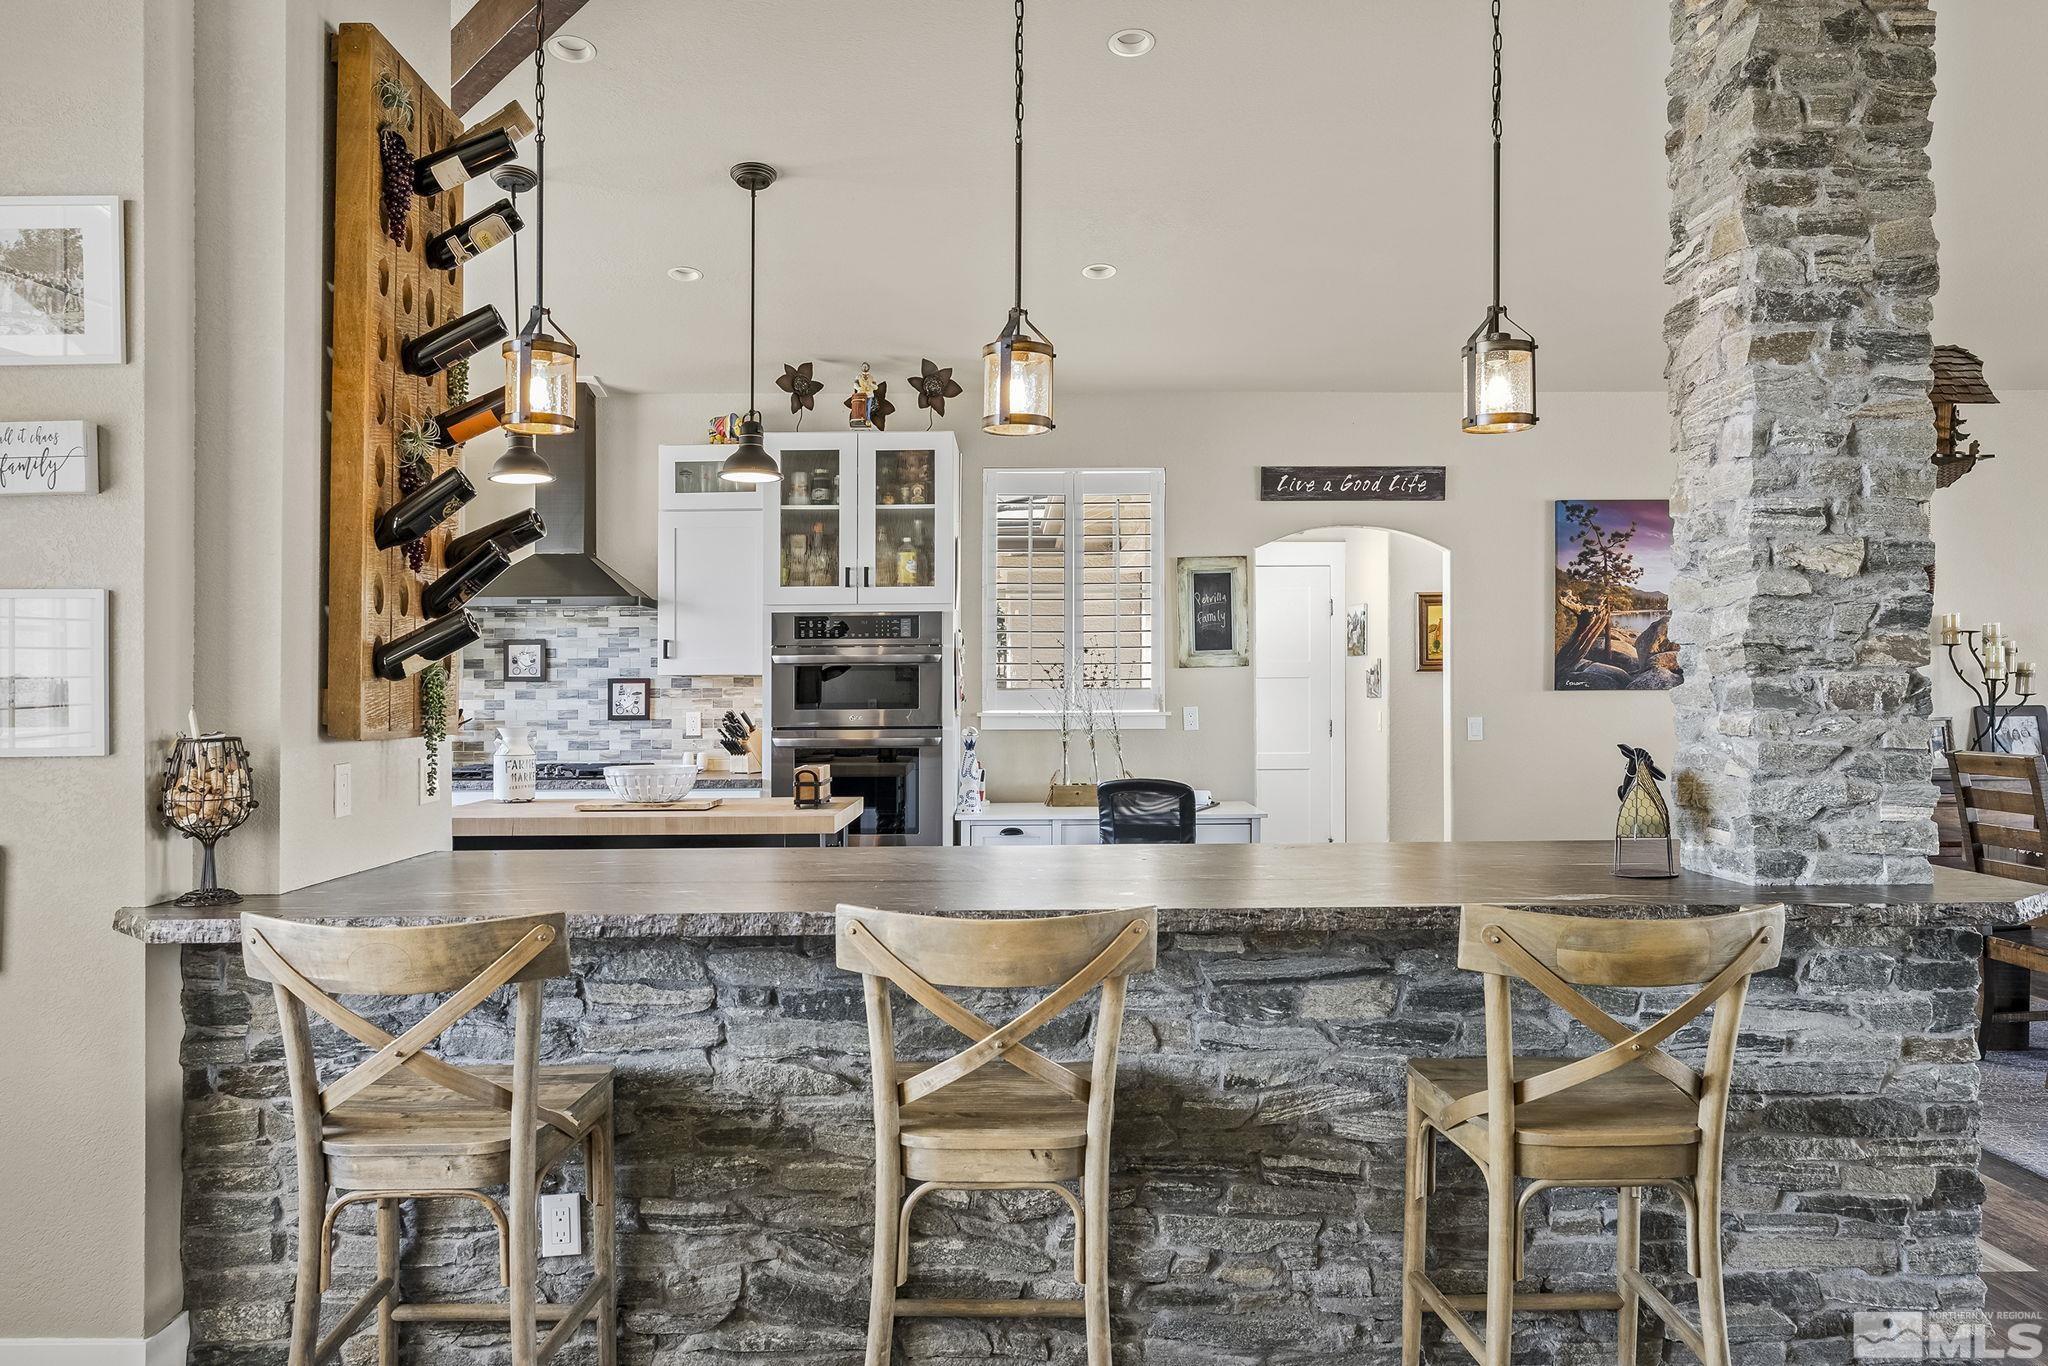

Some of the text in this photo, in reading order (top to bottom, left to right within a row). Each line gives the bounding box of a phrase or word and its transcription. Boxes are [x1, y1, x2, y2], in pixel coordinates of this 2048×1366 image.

[17, 428, 26, 443] it
[30, 425, 59, 445] chaos
[0, 447, 83, 490] family
[1276, 474, 1427, 493] Live a Good Life
